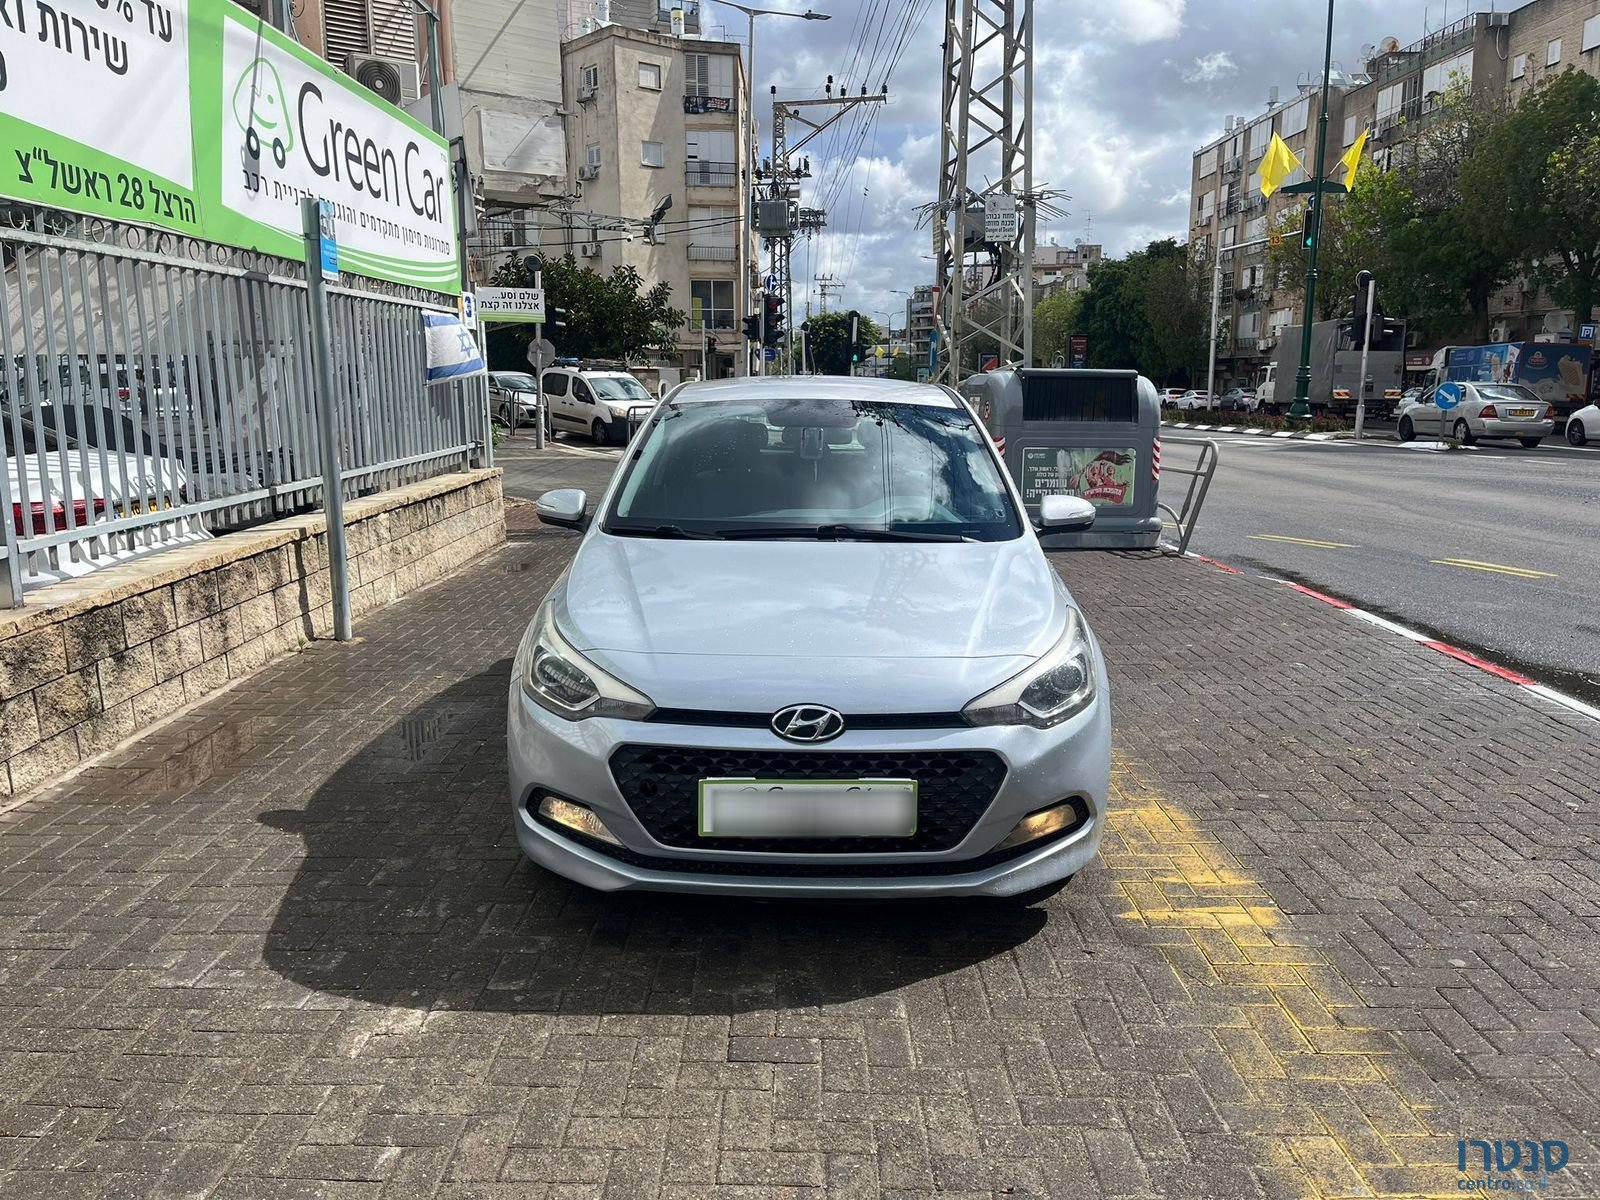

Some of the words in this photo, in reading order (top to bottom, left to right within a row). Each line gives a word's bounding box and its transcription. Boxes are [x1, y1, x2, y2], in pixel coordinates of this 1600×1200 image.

[141, 0, 173, 43] עד
[37, 0, 129, 76] שירות
[298, 81, 401, 208] Green
[405, 141, 444, 224] Car
[15, 146, 113, 203] ראשל"צ
[242, 169, 269, 196] רכב
[117, 173, 145, 211] 28
[149, 180, 197, 224] הרצל
[360, 211, 400, 240] מתקדמים
[401, 226, 422, 247] מימון
[424, 234, 450, 256] פתרונות
[1271, 236, 1280, 244] 13
[480, 300, 500, 311] קצת
[492, 291, 516, 300] וסע...
[502, 301, 512, 309] זה
[515, 301, 540, 310] אצלנו
[520, 291, 539, 300] שלם
